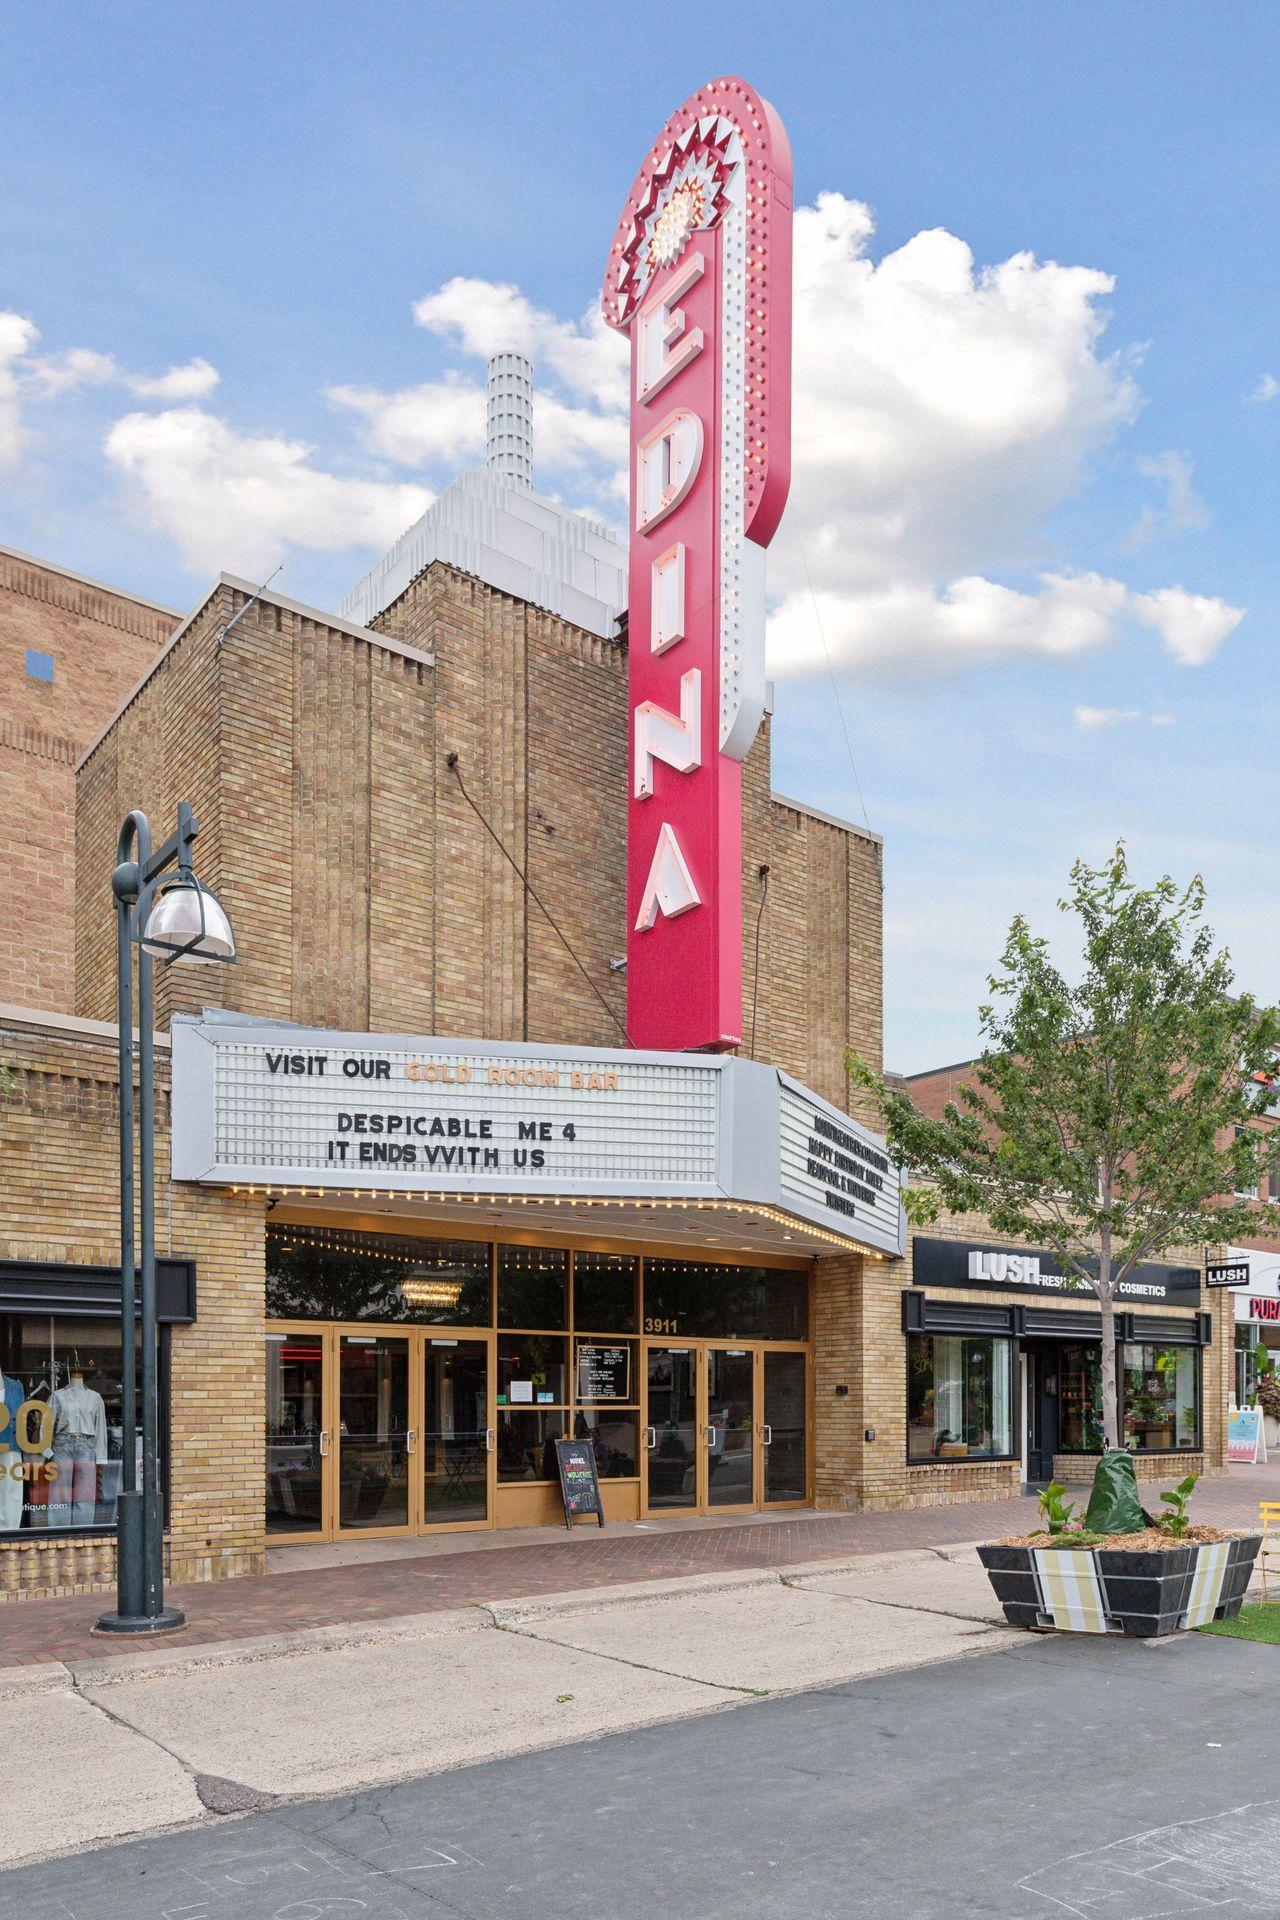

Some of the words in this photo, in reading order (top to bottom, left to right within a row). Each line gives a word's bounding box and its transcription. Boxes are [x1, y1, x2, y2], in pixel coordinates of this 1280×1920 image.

[634, 252, 705, 931] EDINA
[266, 1053, 328, 1075] VISIT
[343, 1058, 391, 1079] OUR
[405, 1060, 472, 1083] GOLD
[488, 1066, 560, 1088] ROOM
[571, 1071, 618, 1091] BAR
[338, 1113, 492, 1138] DESPICABLE
[519, 1121, 552, 1141] ME
[562, 1123, 576, 1141] 4
[328, 1141, 349, 1160] IT
[360, 1142, 417, 1163] ENDS
[514, 1149, 545, 1167] US
[968, 1251, 1040, 1286] LUSH
[1119, 1282, 1166, 1297] COSMETICS
[1208, 1268, 1247, 1282] LUSH
[645, 1318, 677, 1333] 3911
